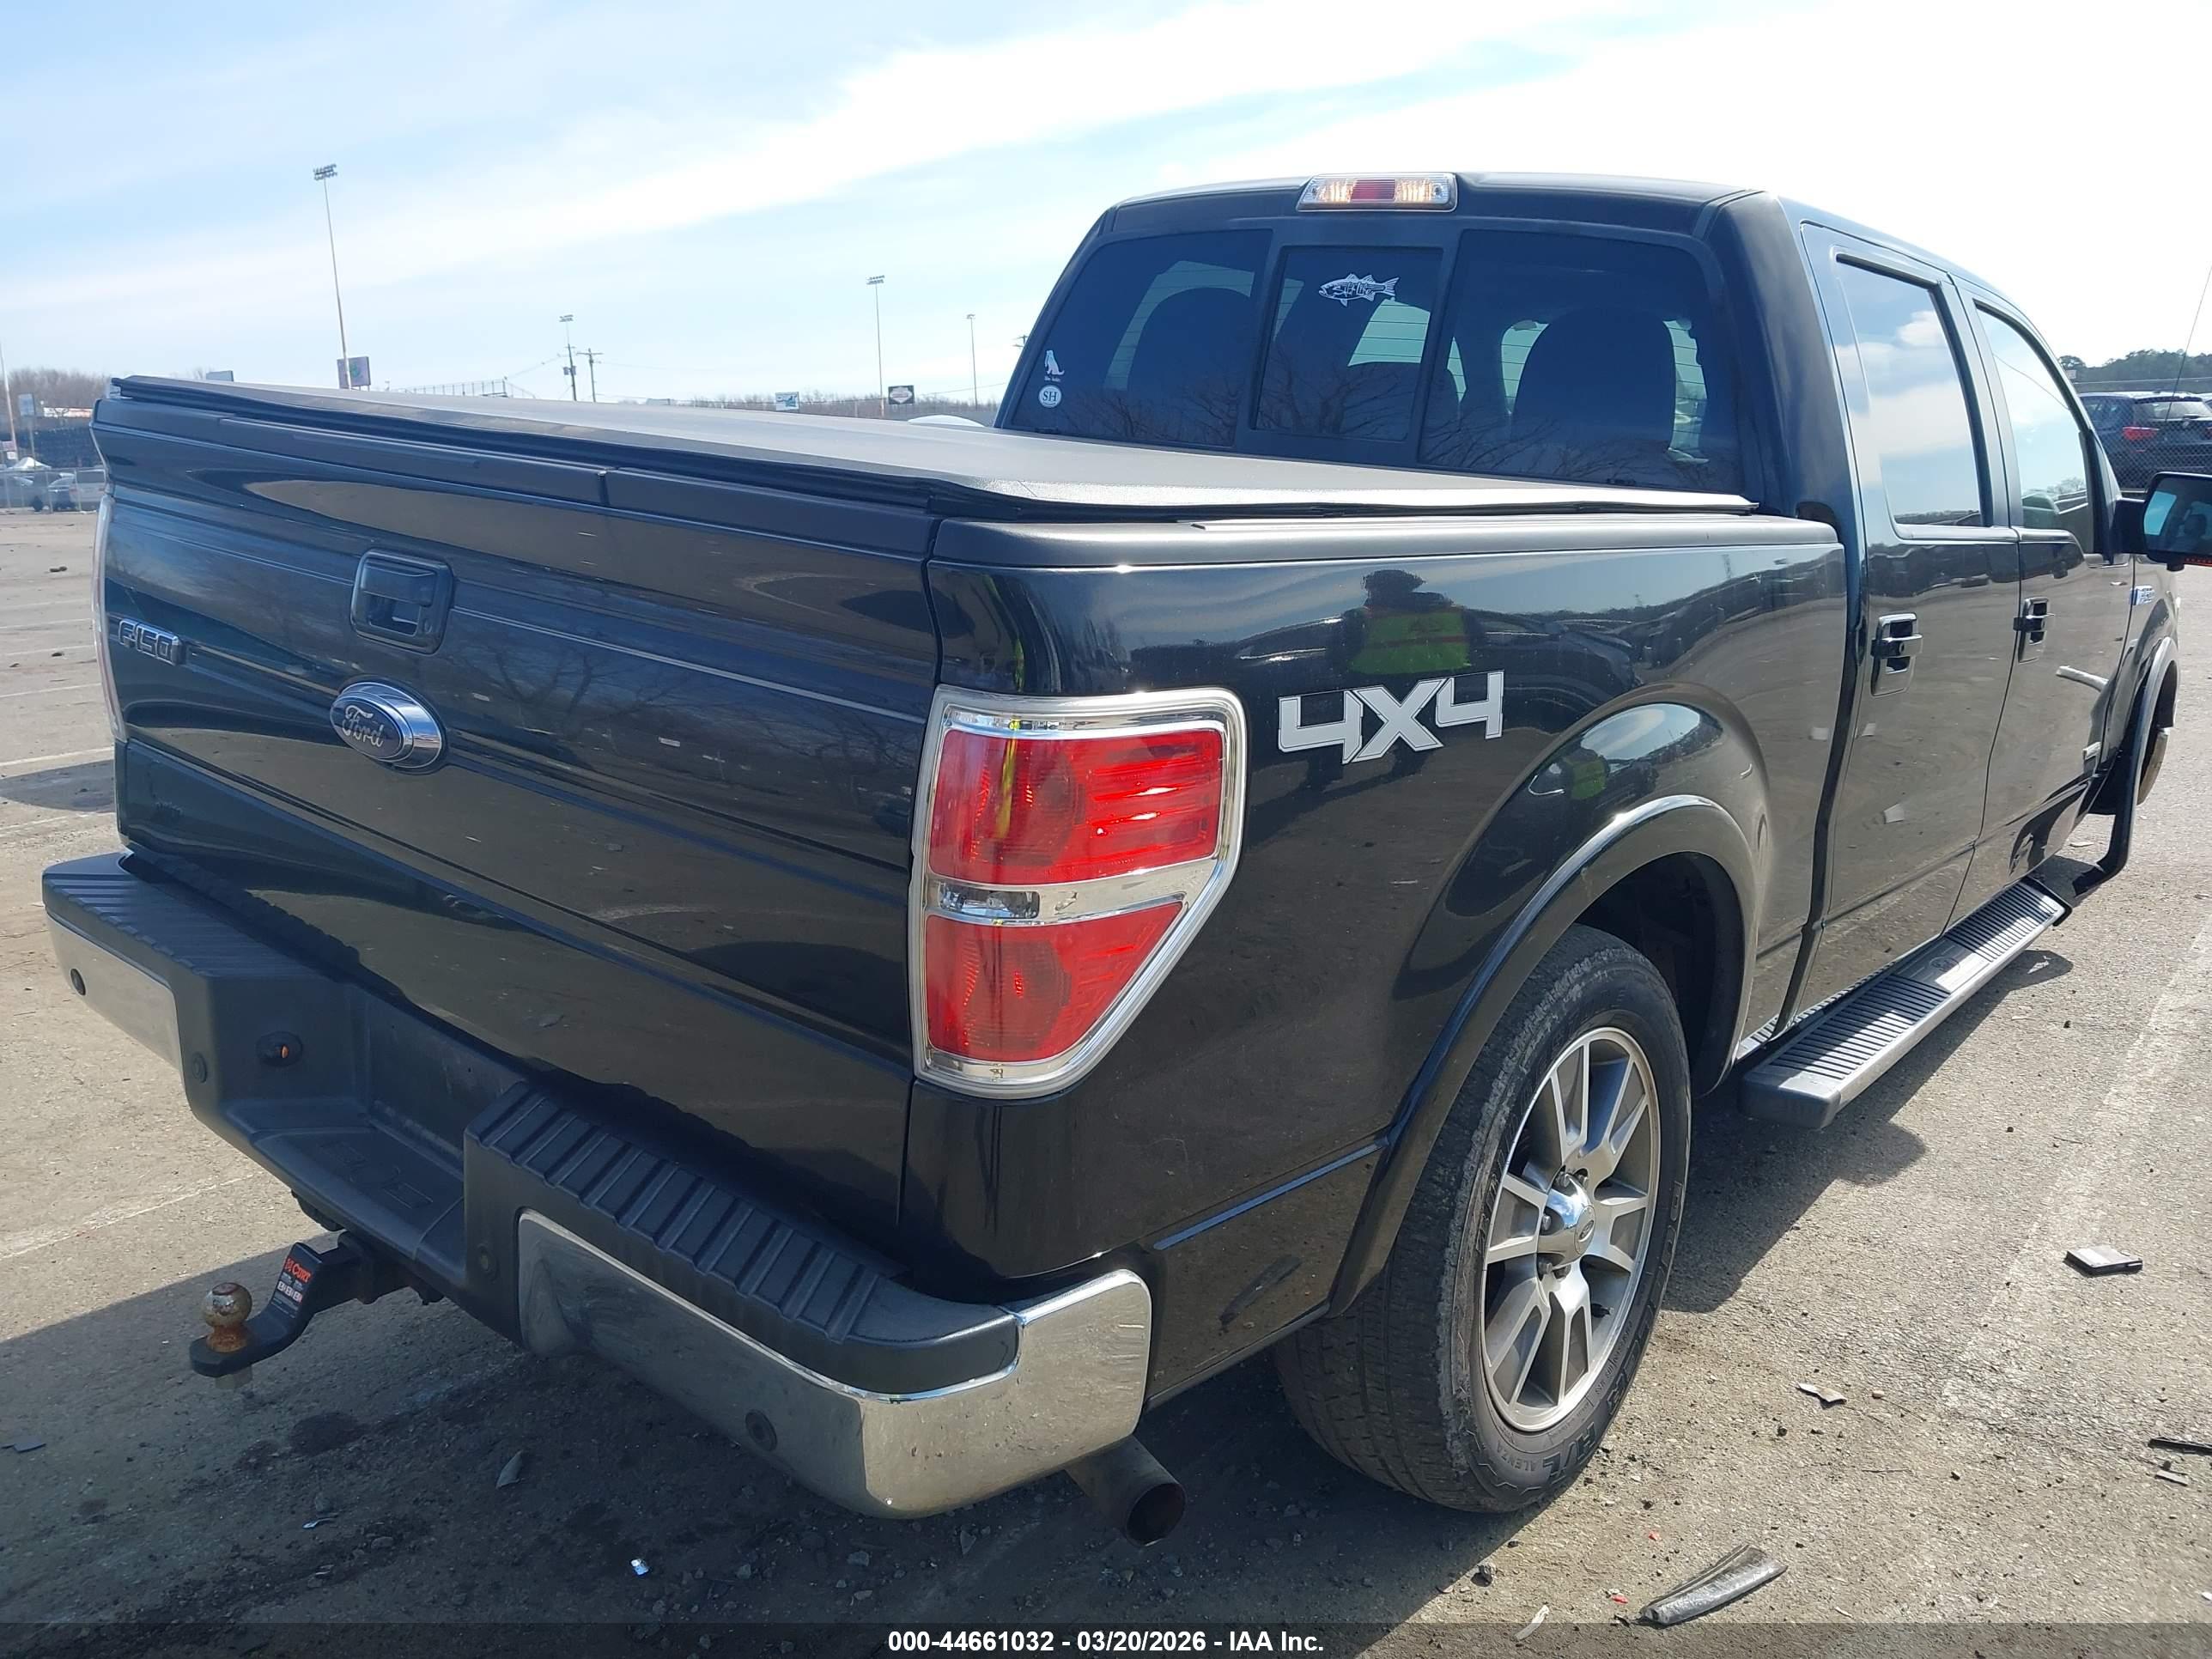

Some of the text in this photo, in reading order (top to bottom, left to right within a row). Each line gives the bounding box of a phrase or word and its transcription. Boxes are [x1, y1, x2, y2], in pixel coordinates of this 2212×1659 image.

[1042, 390, 1058, 402] SH
[342, 704, 385, 747] Ford
[1496, 1438, 1539, 1472] ALENZA
